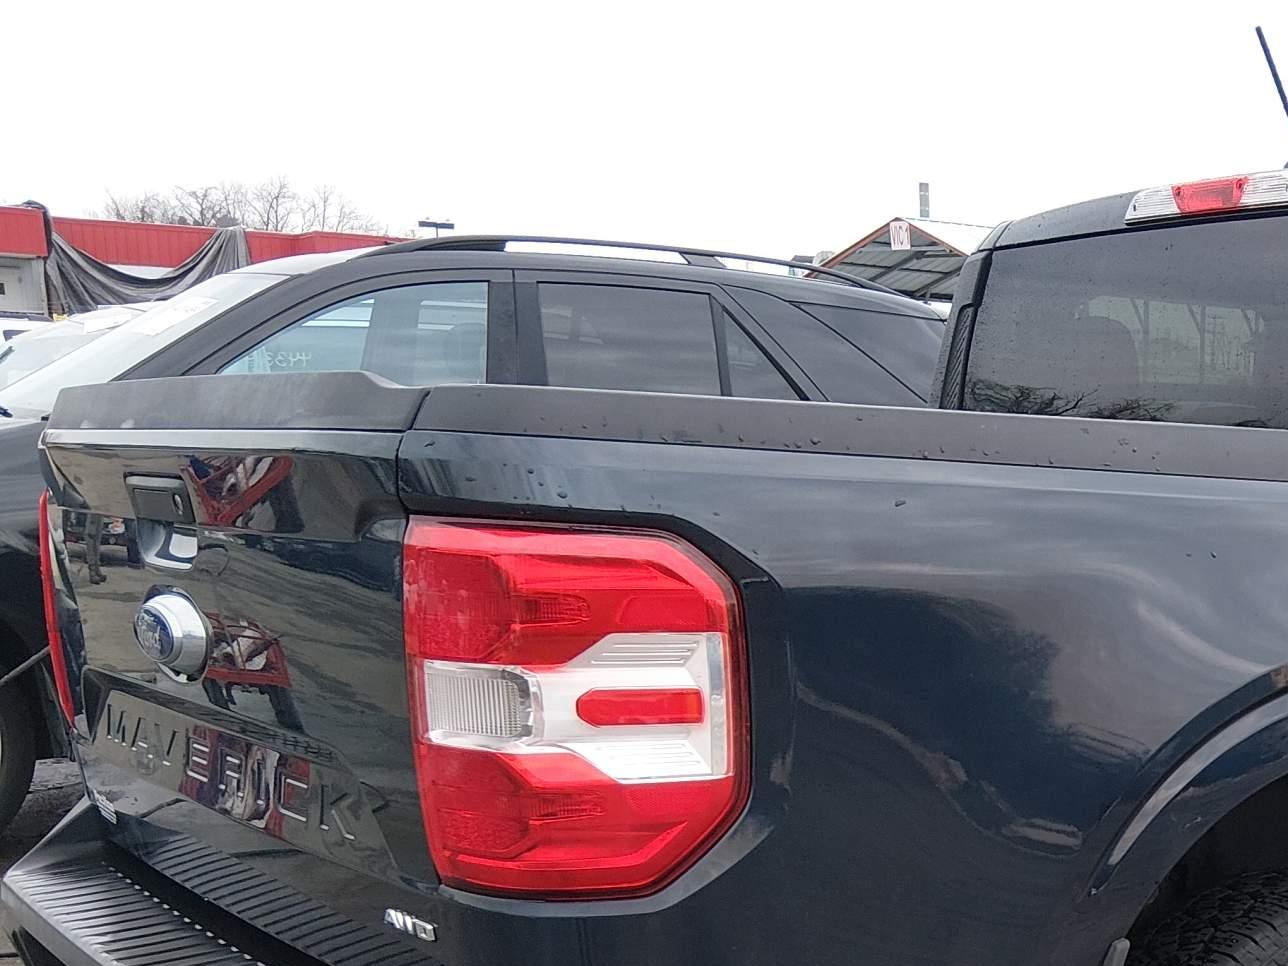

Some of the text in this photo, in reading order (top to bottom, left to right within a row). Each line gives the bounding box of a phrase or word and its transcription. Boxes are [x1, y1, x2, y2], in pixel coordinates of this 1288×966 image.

[890, 225, 910, 246] VIC 1
[105, 703, 358, 840] MAVERICK
[383, 908, 438, 941] AWD
